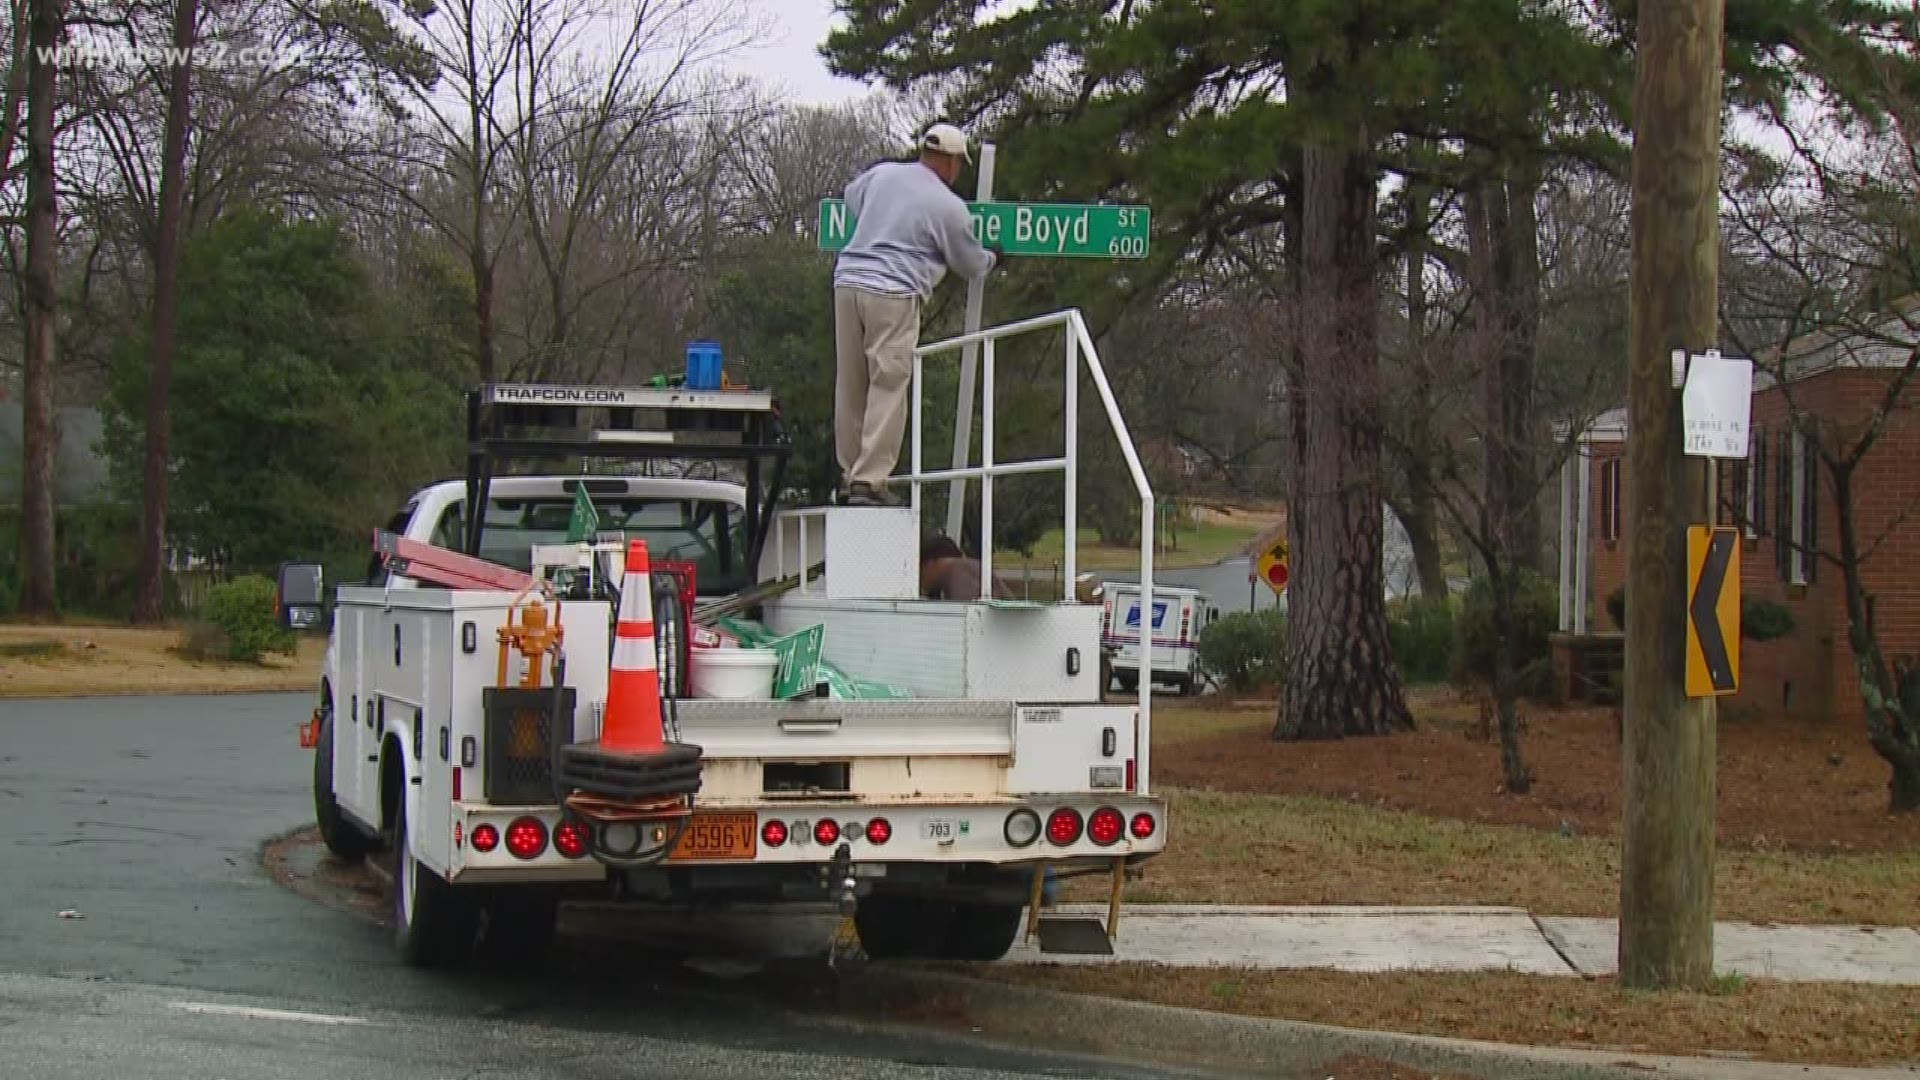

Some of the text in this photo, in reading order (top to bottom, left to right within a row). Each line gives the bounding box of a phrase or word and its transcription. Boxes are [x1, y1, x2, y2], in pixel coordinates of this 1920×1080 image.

[829, 203, 846, 240] N
[1016, 207, 1089, 252] Boyd
[1117, 209, 1137, 228] St
[1108, 235, 1145, 256] 600
[496, 388, 625, 403] TRAFCON.COM
[928, 822, 950, 838] 703
